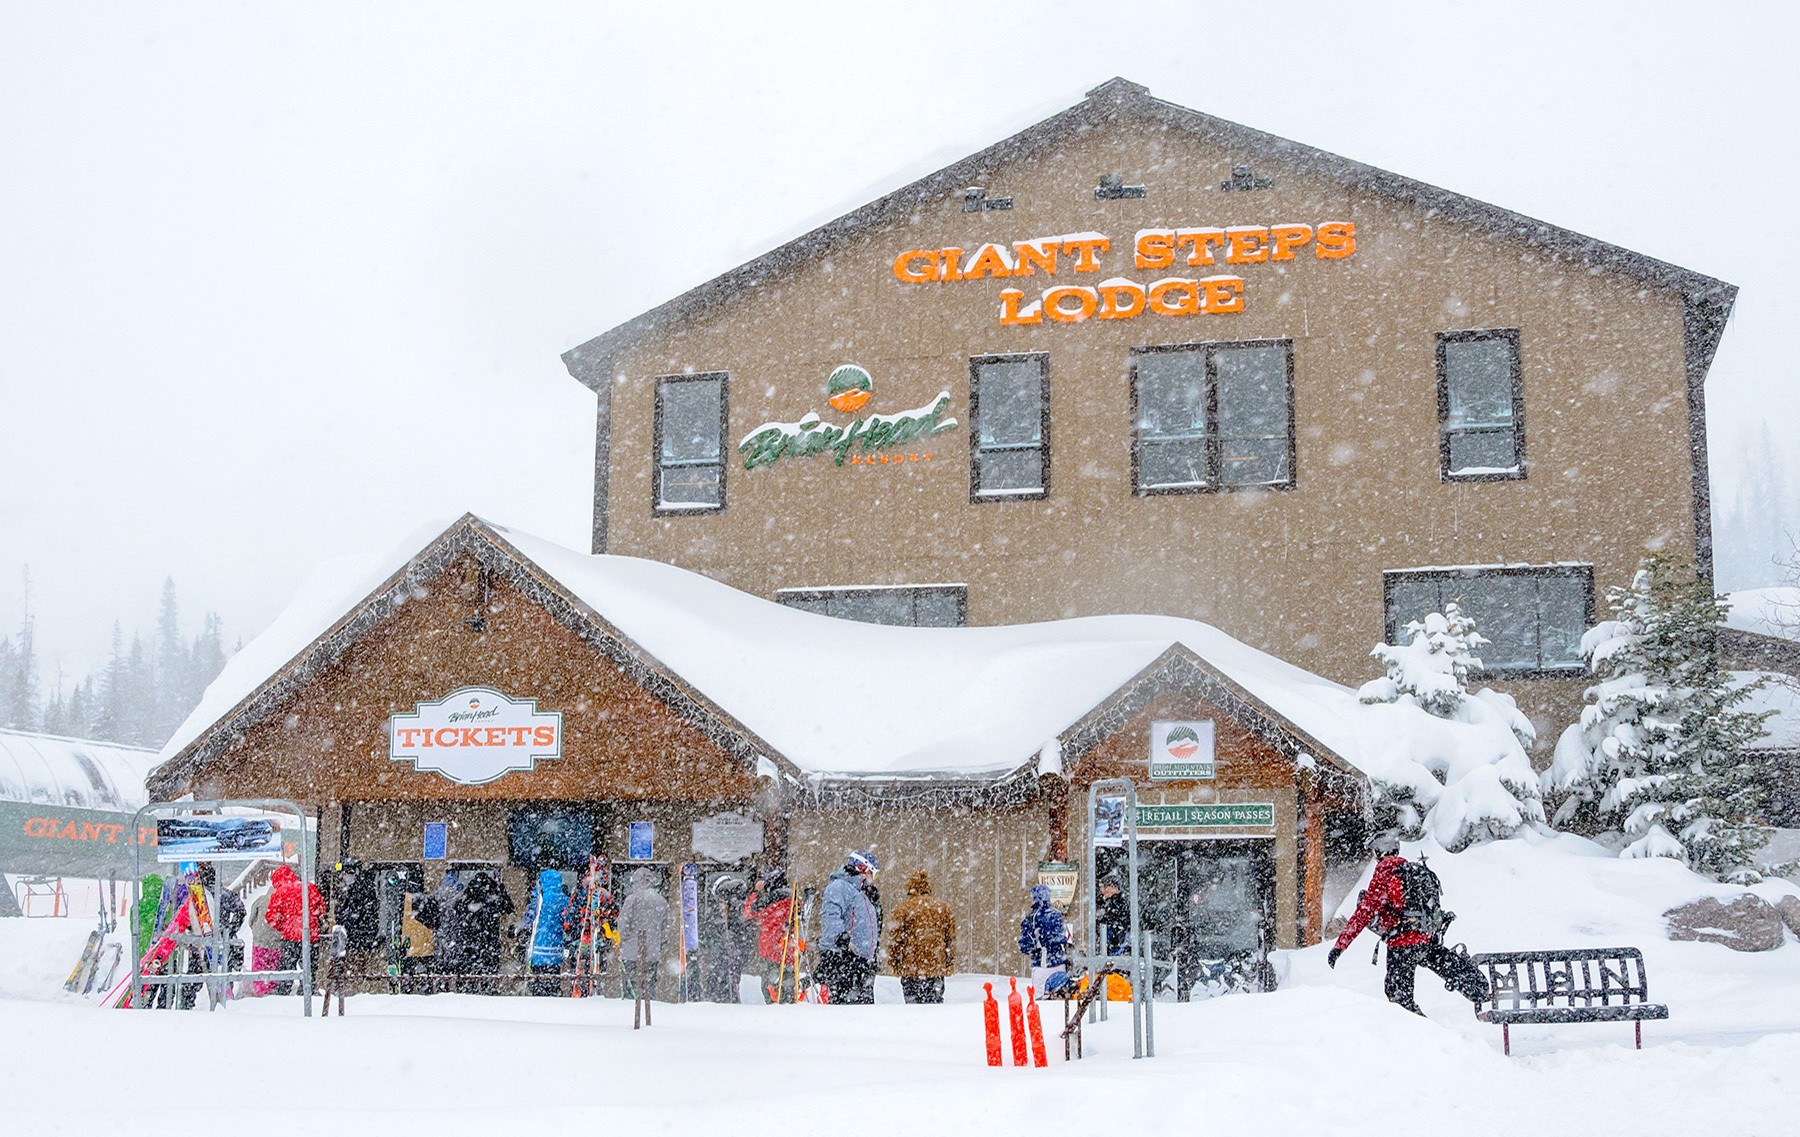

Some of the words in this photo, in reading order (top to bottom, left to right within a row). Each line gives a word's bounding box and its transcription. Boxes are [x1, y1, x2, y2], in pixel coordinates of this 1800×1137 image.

[893, 235, 1110, 283] GIANT
[1135, 223, 1356, 269] STEPS
[1000, 277, 1244, 325] LODGE
[397, 726, 555, 748] TICKETS
[1147, 811, 1182, 821] RETAIL
[1191, 811, 1231, 821] SEASON
[1235, 810, 1271, 820] PASSES
[24, 818, 125, 844] GIANT
[1041, 874, 1057, 886] BUS
[1057, 874, 1075, 886] STOP
